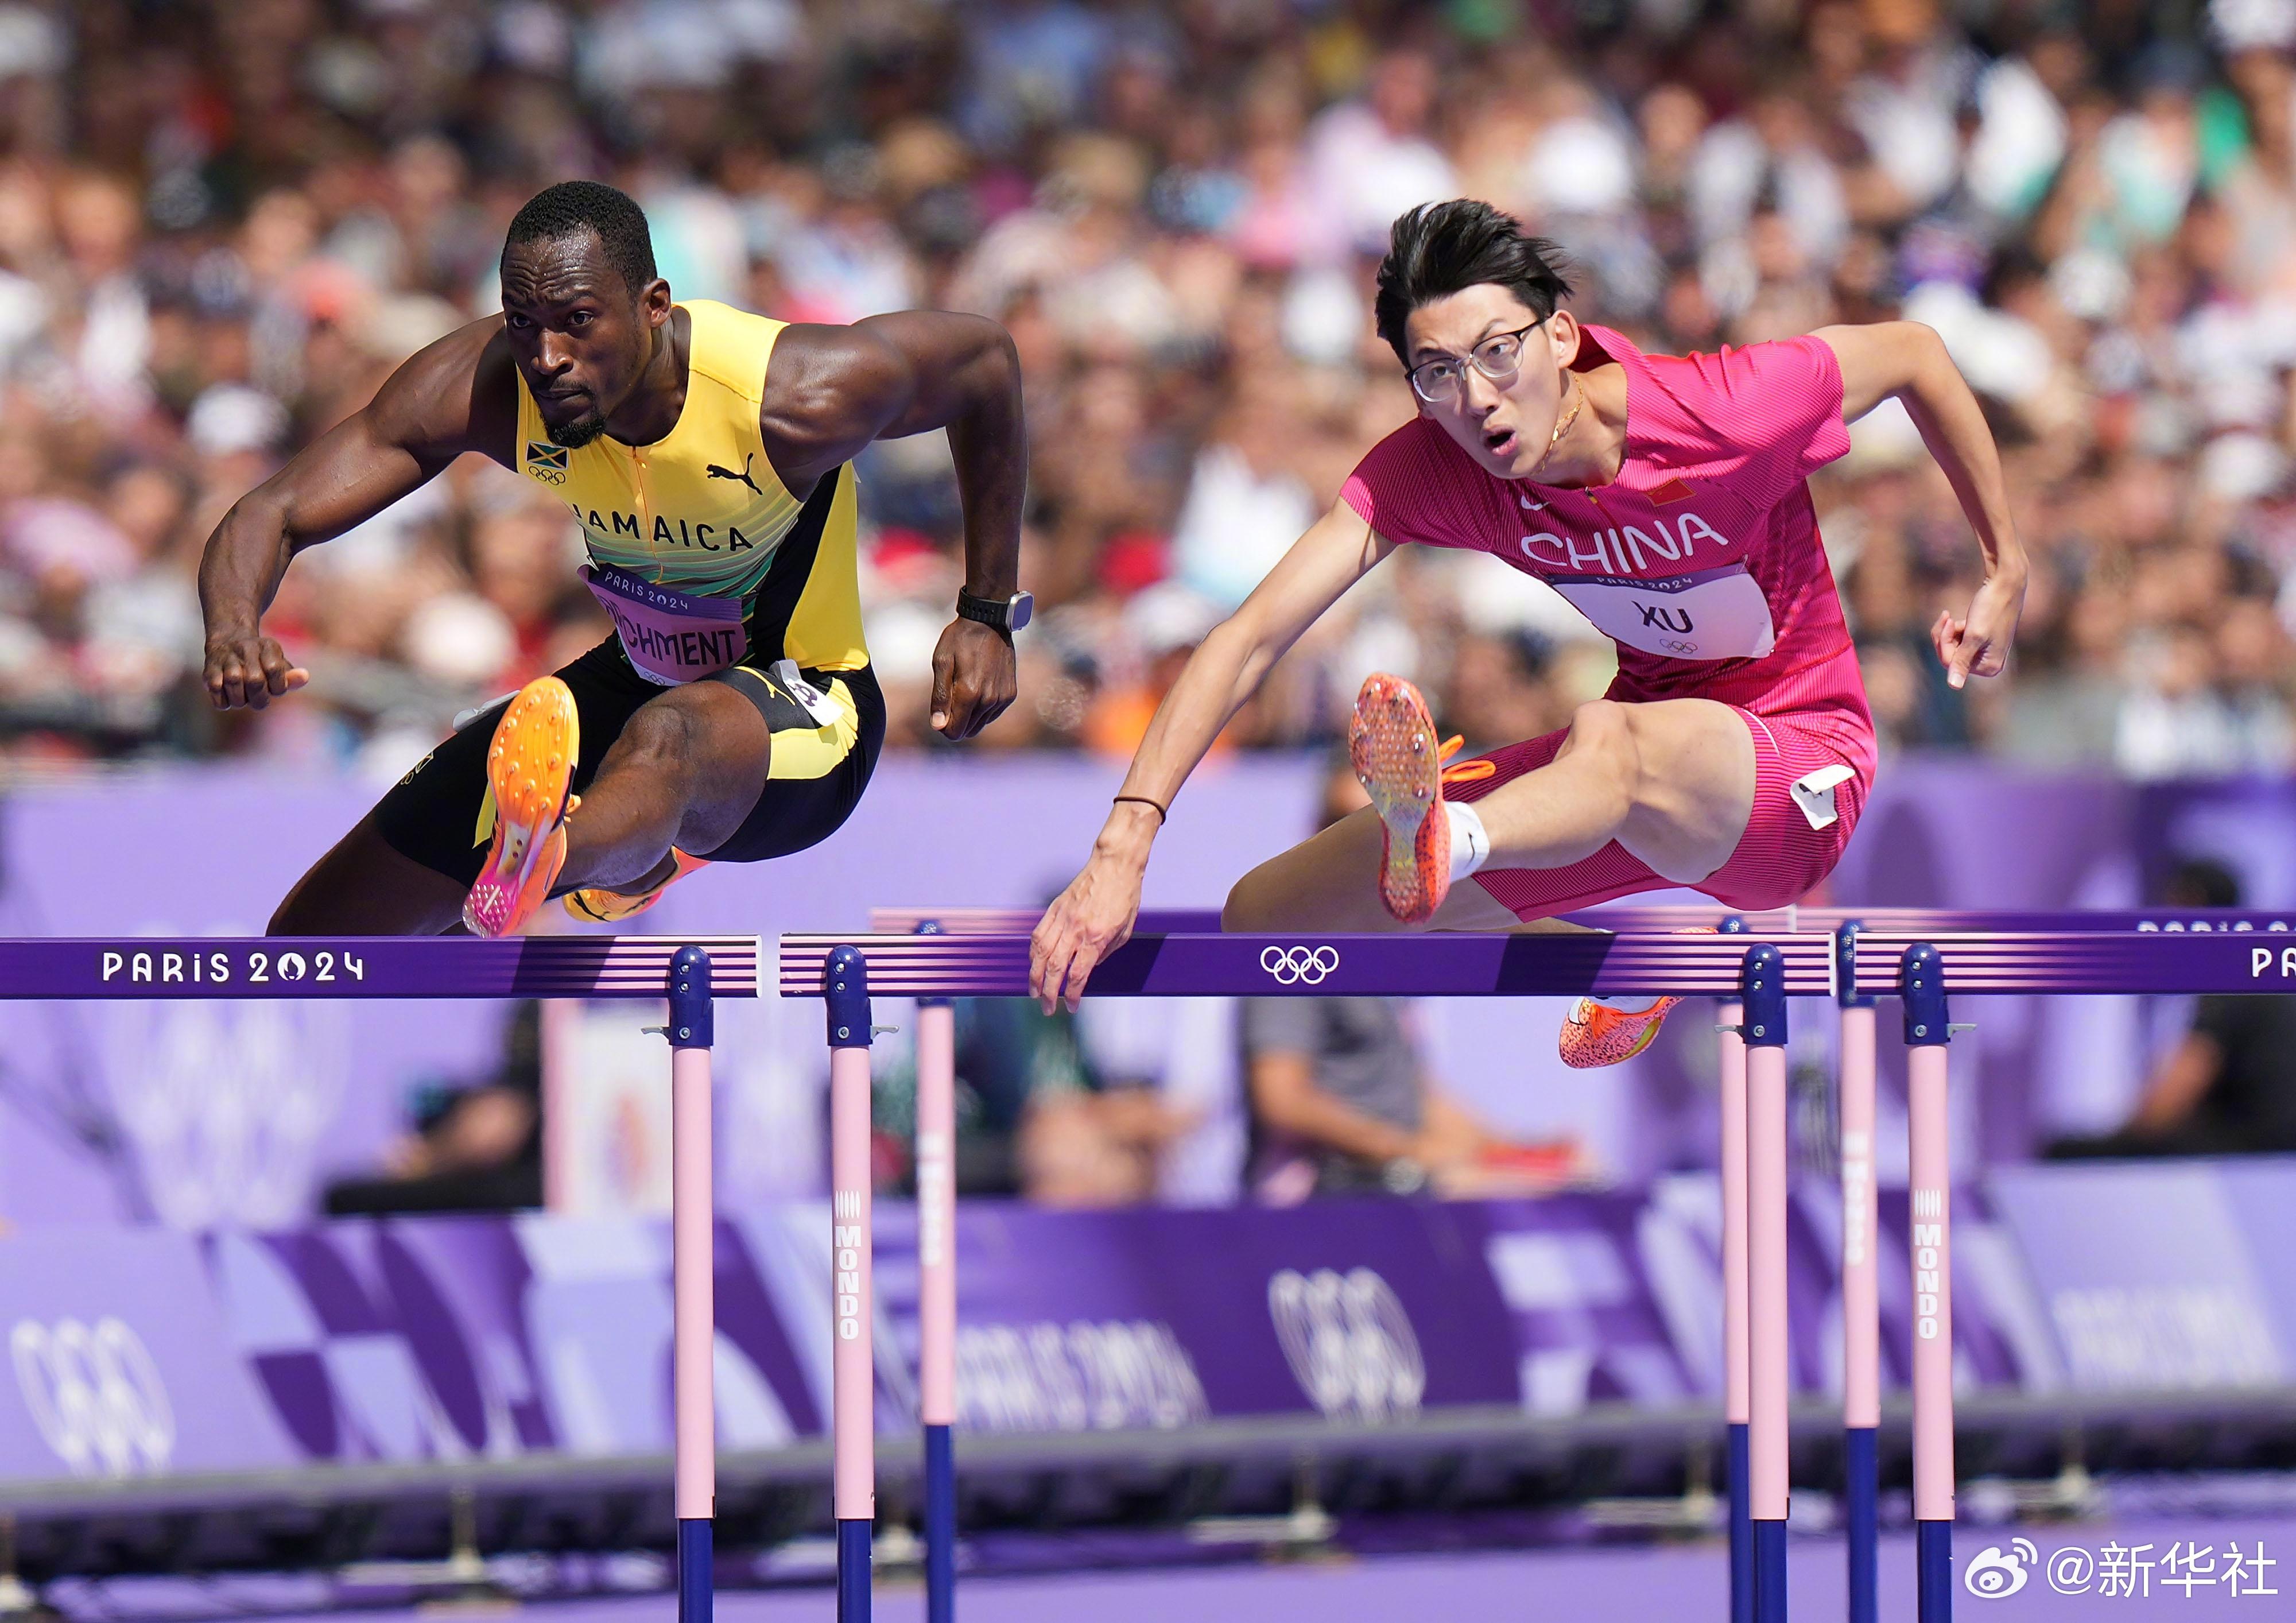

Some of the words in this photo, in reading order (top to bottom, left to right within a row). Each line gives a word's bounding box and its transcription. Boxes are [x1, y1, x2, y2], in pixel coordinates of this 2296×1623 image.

[572, 503, 753, 551] JAMAICA
[1521, 512, 1729, 574] CHINA
[648, 590, 688, 610] 2024
[1648, 577, 1693, 590] 2024
[1631, 600, 1694, 633] XU
[249, 951, 364, 982] 2024
[835, 1225, 861, 1340] MONDO
[1915, 1224, 1941, 1339] MONDO
